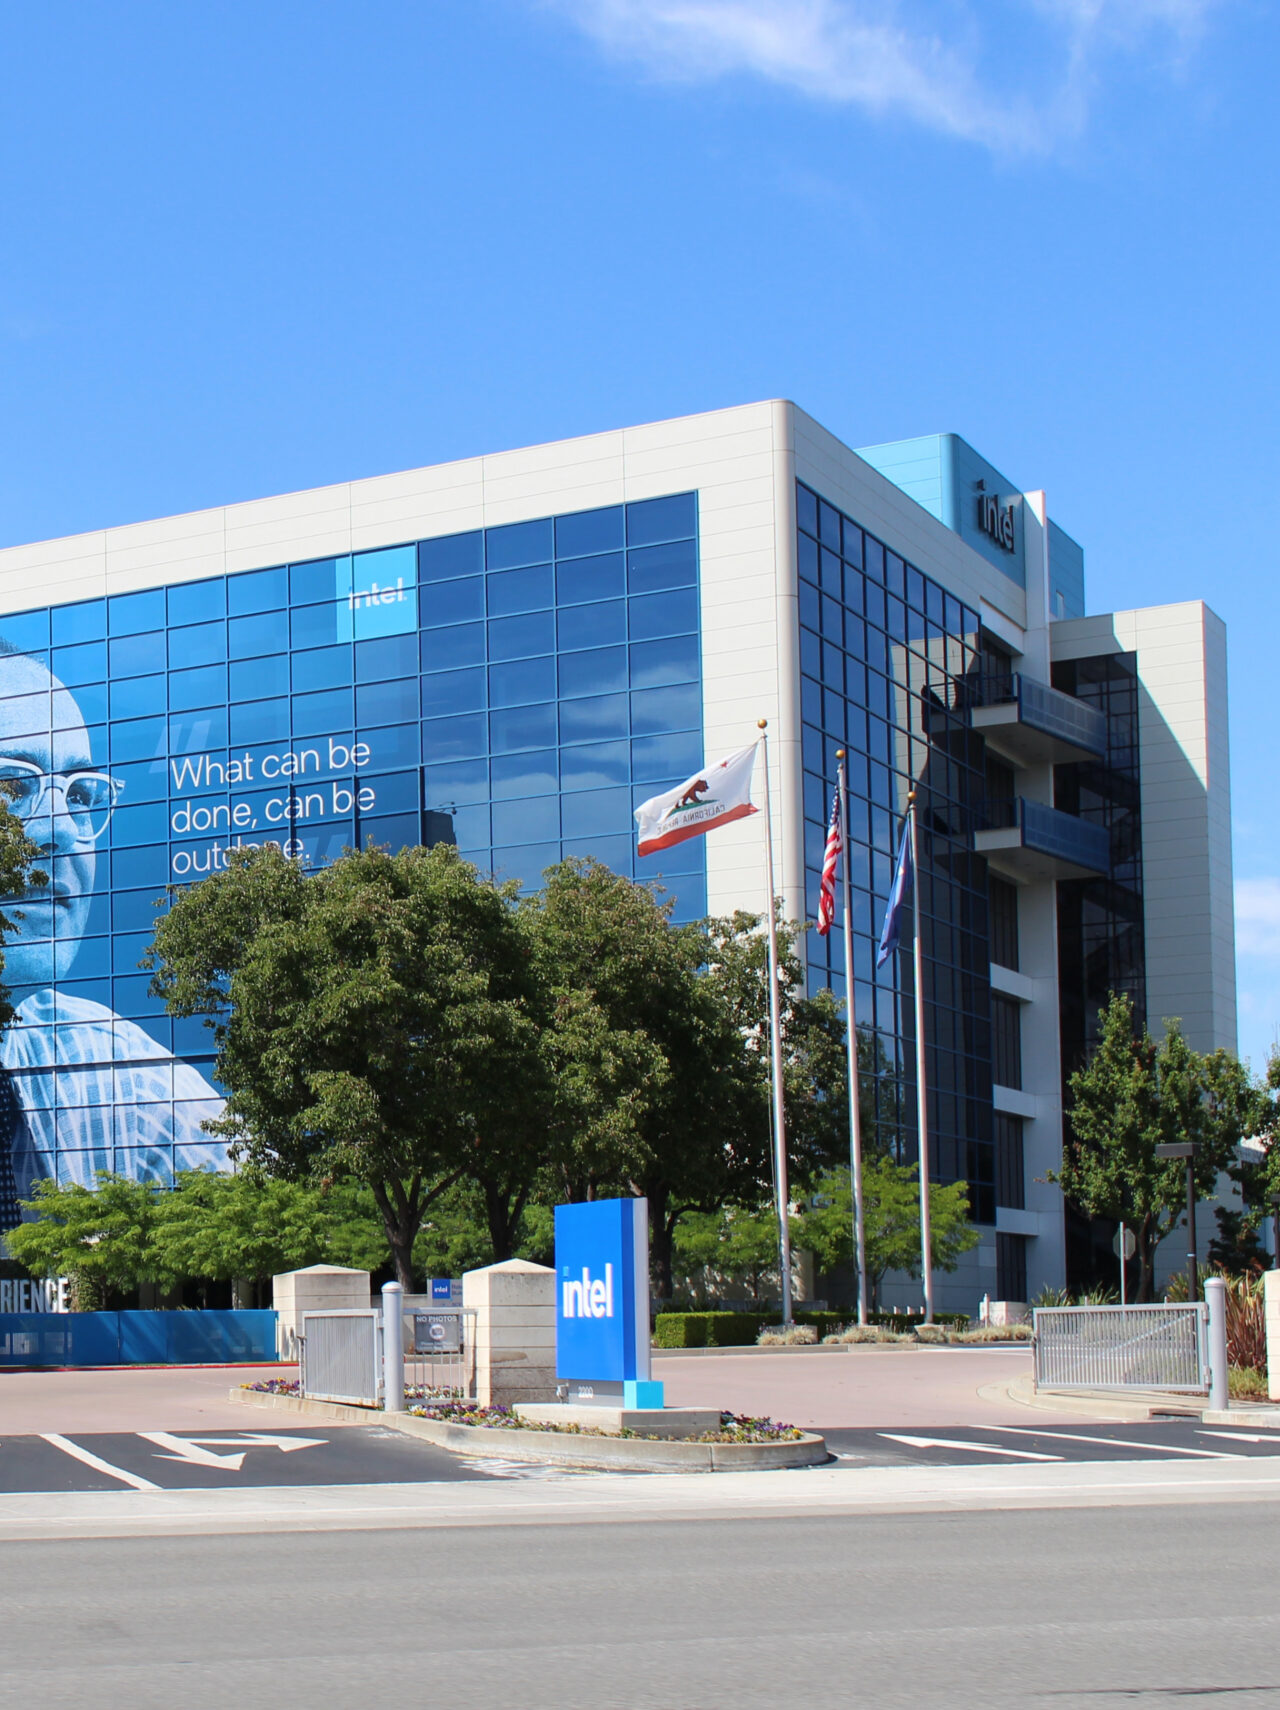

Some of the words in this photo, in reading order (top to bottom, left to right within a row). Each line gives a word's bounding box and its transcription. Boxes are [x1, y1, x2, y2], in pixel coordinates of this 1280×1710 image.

[976, 478, 1016, 555] intel
[171, 752, 253, 790] What
[261, 749, 320, 779] can
[329, 737, 371, 770] be
[171, 800, 258, 833] done,
[265, 793, 324, 822] can
[333, 781, 376, 814] be
[172, 835, 310, 875] outde.
[434, 1286, 448, 1294] intel
[562, 1263, 614, 1318] intel
[416, 1315, 428, 1323] NO
[428, 1315, 458, 1323] PHOTOS
